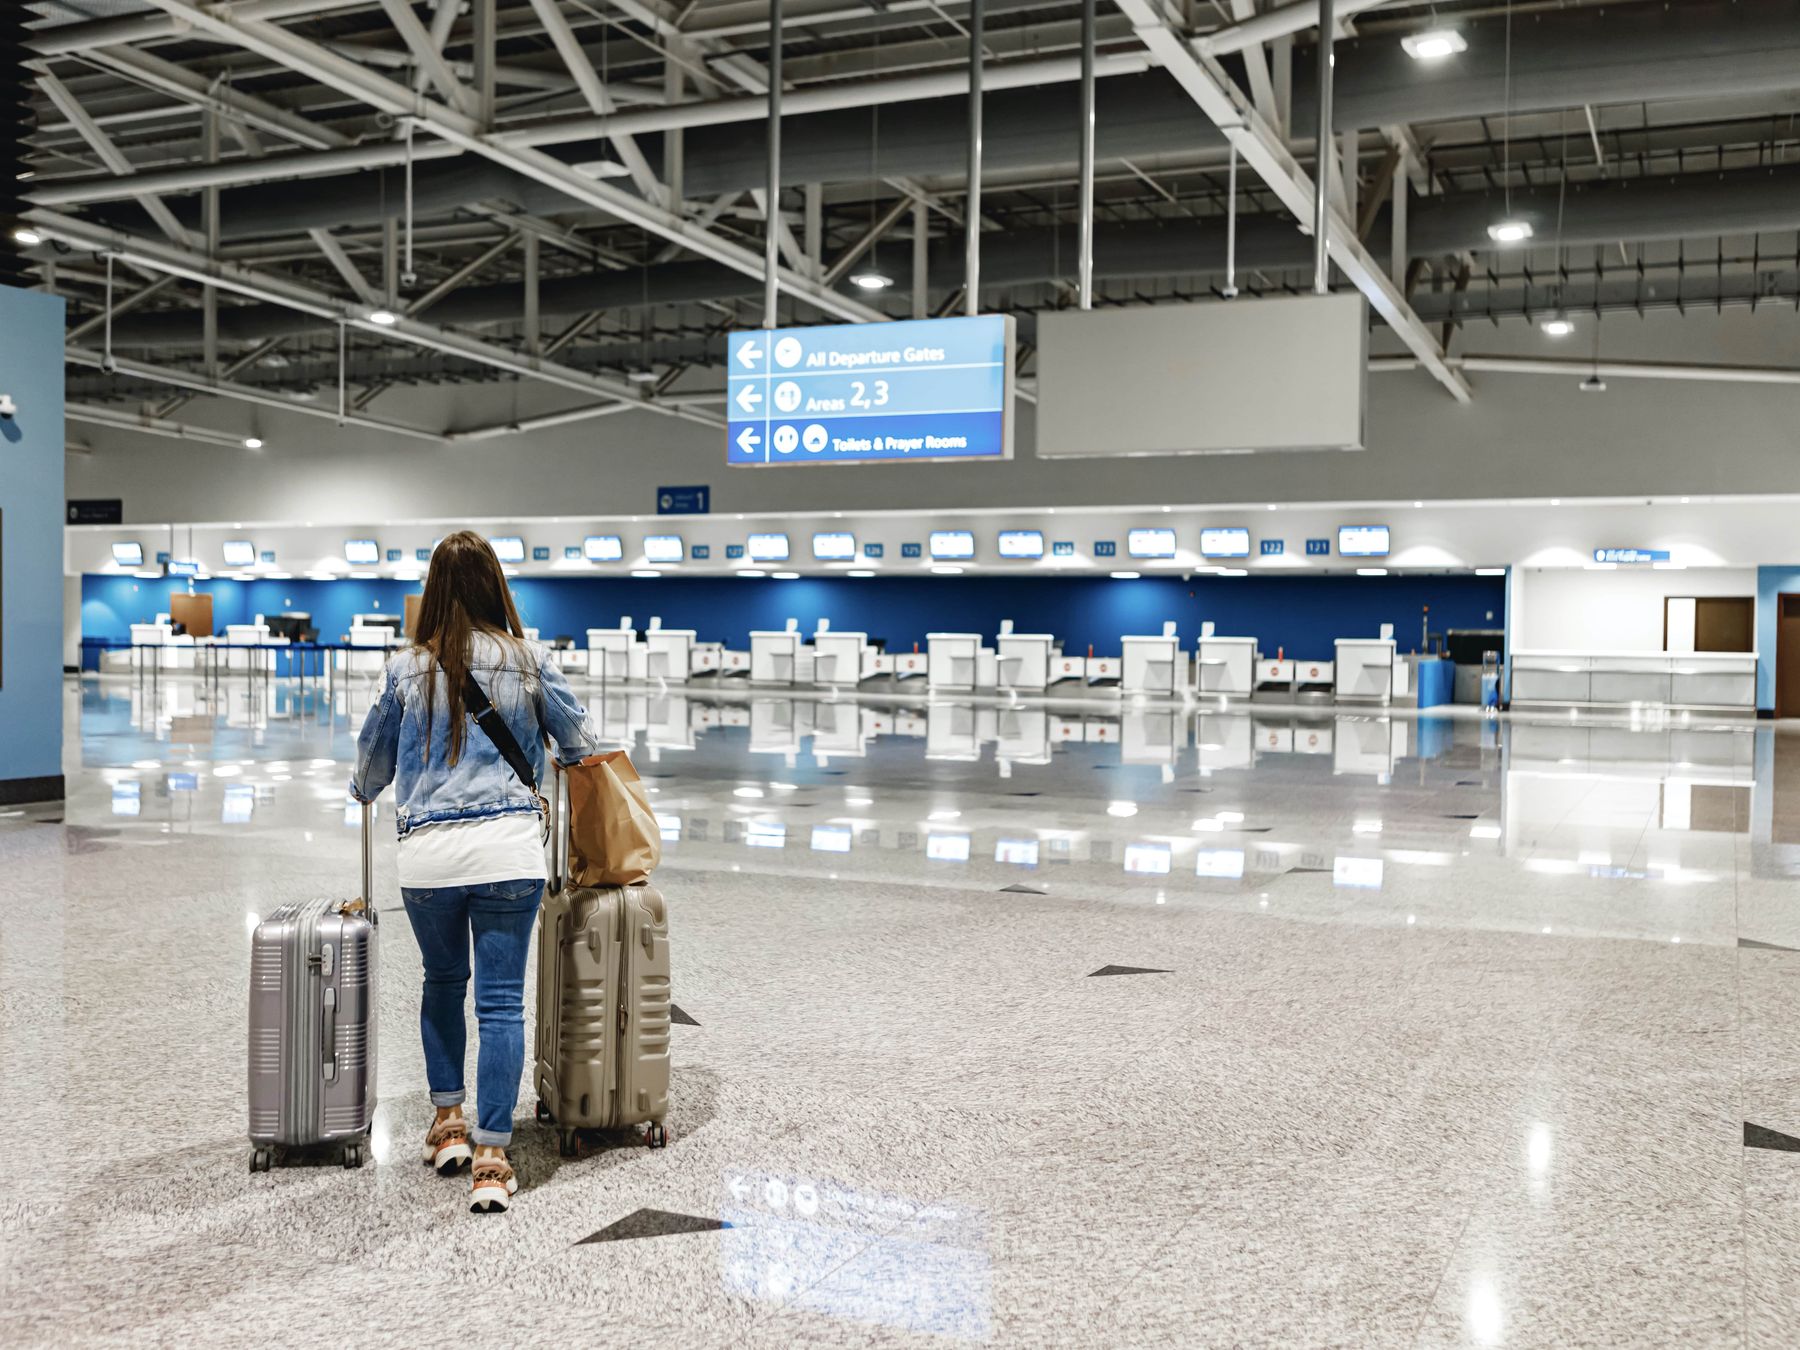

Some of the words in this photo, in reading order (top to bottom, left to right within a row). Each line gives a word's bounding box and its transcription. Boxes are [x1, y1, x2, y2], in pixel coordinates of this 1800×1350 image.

[806, 351, 826, 368] All
[829, 350, 901, 368] Departure
[903, 347, 945, 363] Gates
[806, 398, 845, 411] Areas
[850, 380, 889, 408] 2,3
[832, 438, 872, 452] Toilets
[873, 436, 884, 451] &
[885, 436, 924, 453] Prayer
[925, 434, 967, 449] Rooms
[696, 491, 704, 510] 1
[1263, 542, 1282, 553] 122
[1308, 542, 1328, 553] 121
